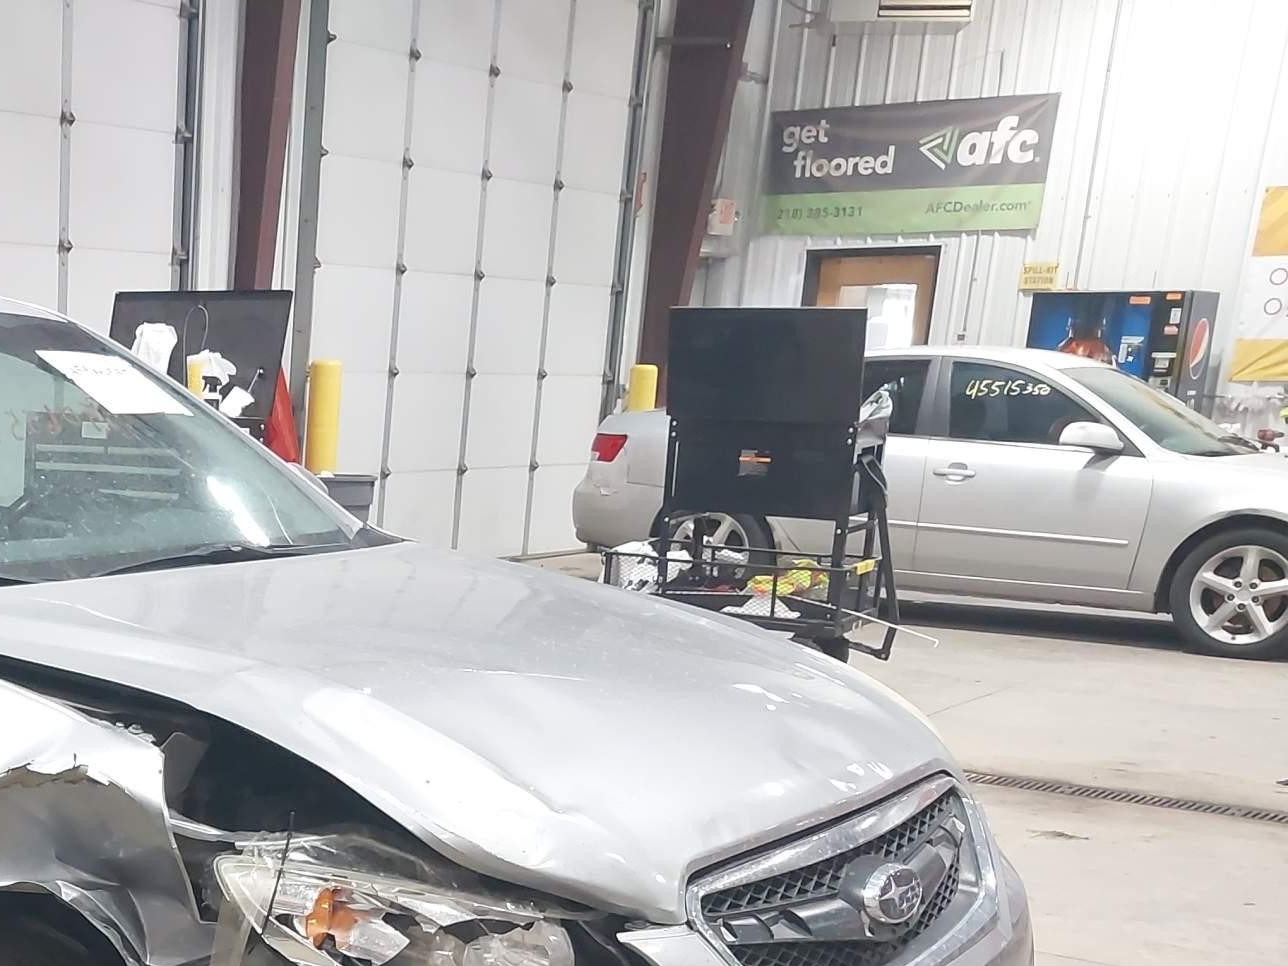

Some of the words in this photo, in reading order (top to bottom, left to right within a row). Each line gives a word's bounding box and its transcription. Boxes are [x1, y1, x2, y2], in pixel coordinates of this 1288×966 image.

[782, 120, 830, 153] get
[793, 145, 896, 178] floored
[966, 380, 1051, 399] 45515350
